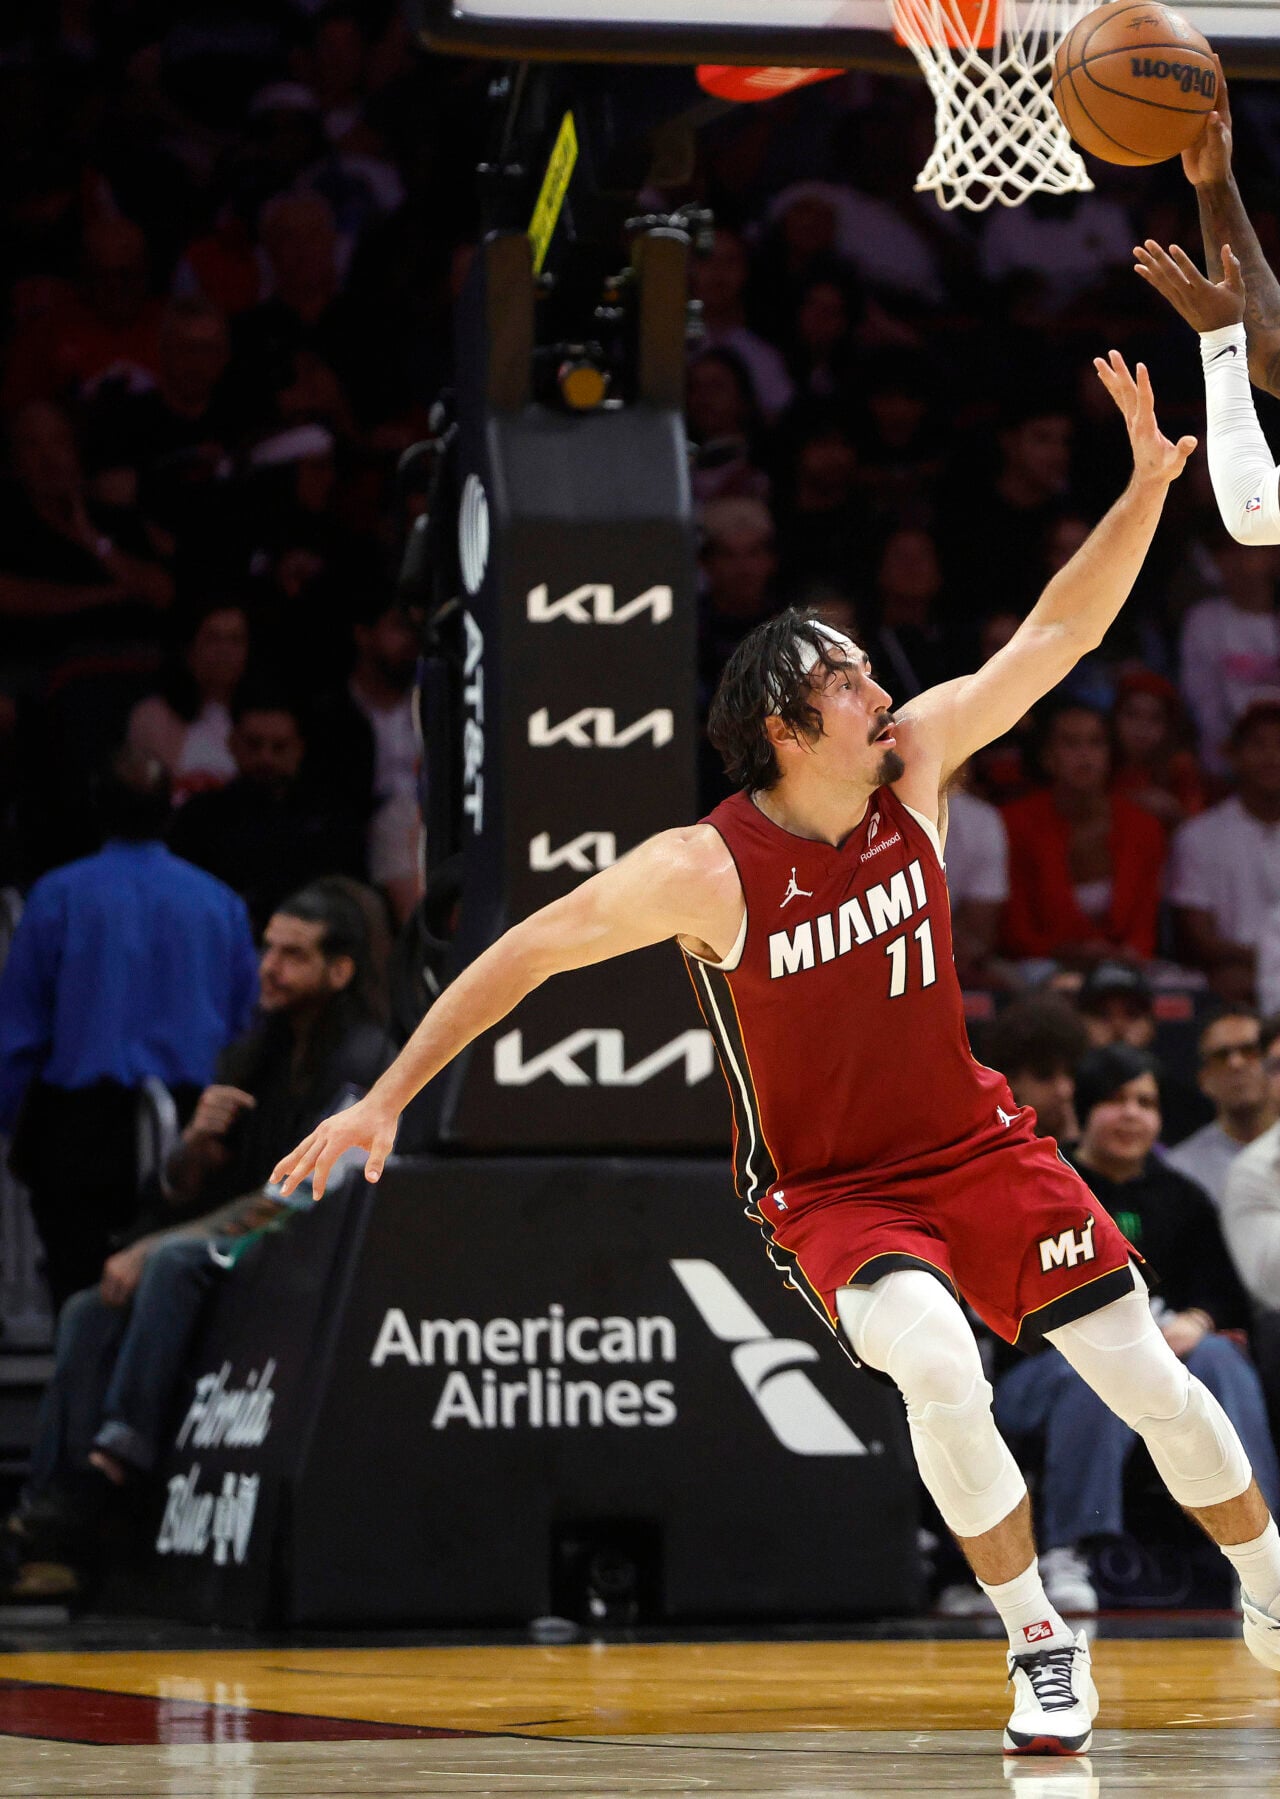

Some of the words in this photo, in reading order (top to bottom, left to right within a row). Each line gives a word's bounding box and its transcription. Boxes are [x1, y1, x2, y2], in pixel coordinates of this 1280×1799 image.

[1131, 58, 1216, 99] Wilson
[527, 583, 673, 624] KIA
[463, 610, 485, 835] AT&T
[528, 707, 674, 748] KIA
[529, 831, 618, 872] KI
[860, 831, 902, 863] Robinhood
[769, 858, 928, 980] MIAMI
[885, 917, 936, 998] 11
[494, 1027, 715, 1087] KIA
[370, 1303, 677, 1366] American
[175, 1357, 276, 1450] Florida
[432, 1368, 678, 1430] Airlines
[157, 1462, 213, 1554] Blue
